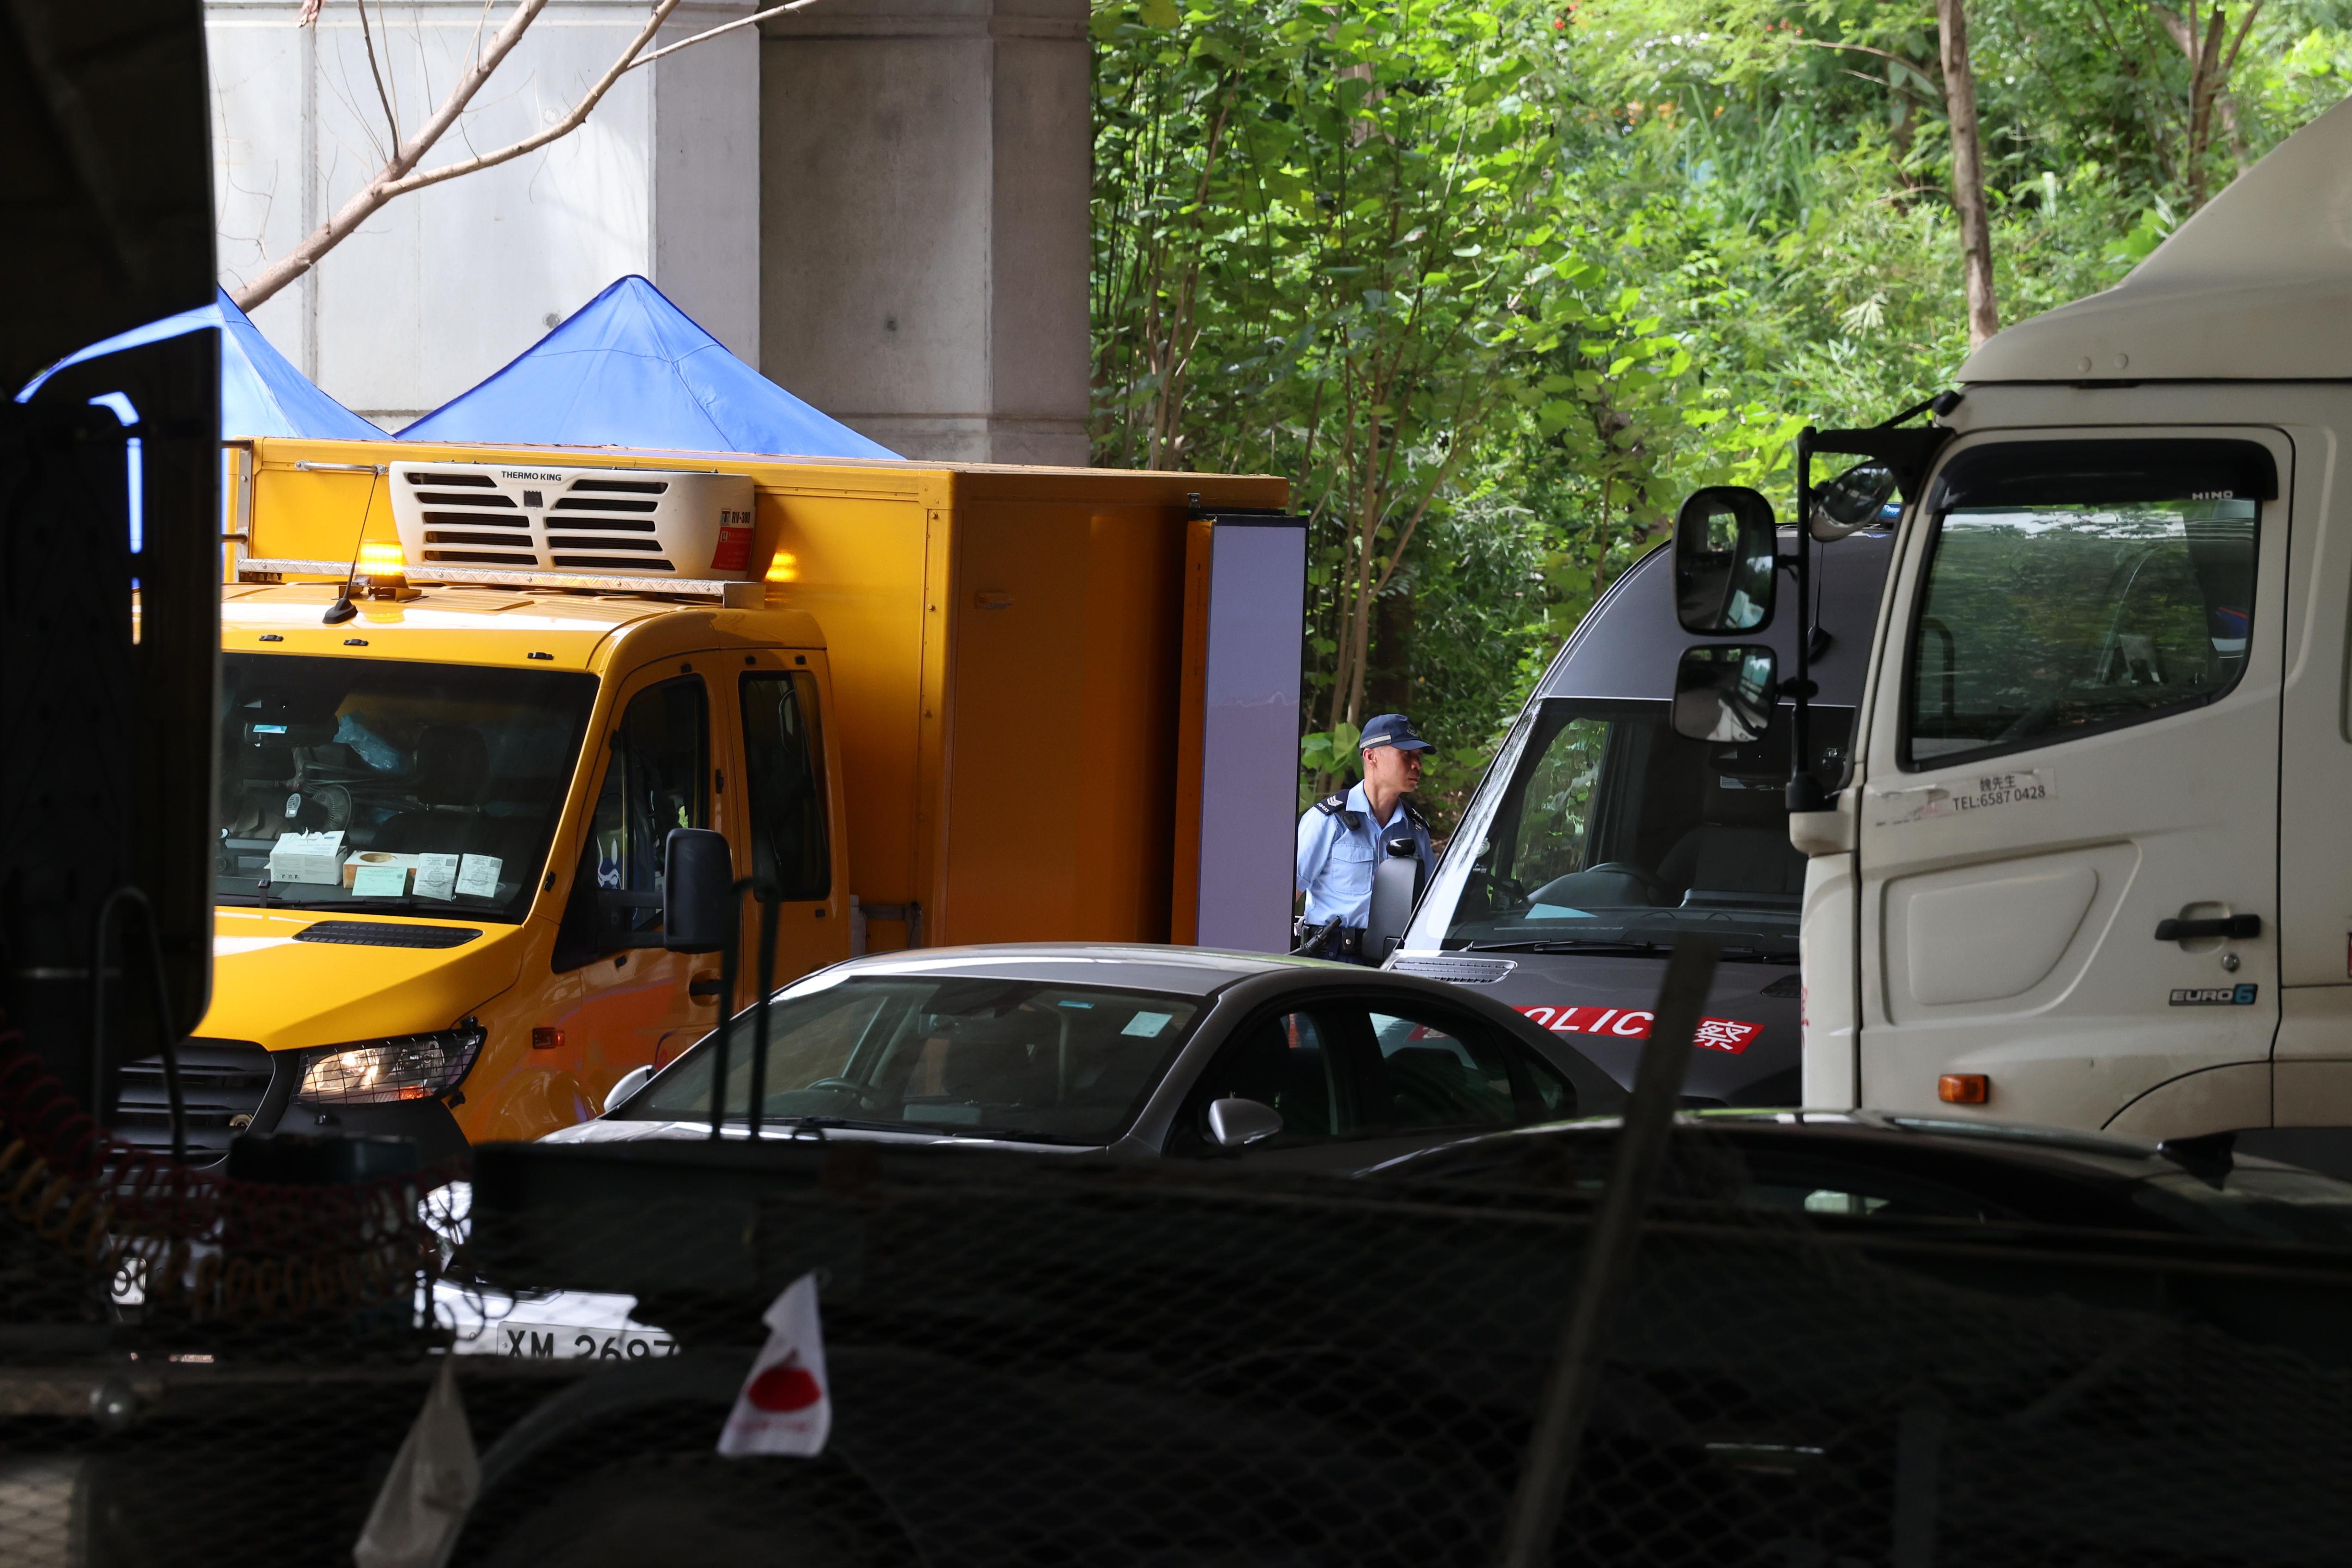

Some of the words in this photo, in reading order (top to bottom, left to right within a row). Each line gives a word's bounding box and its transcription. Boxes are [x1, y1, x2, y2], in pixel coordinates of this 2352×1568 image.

[502, 471, 539, 479] THERMO
[2192, 490, 2233, 500] HINO
[732, 511, 751, 523] RV-380
[1953, 791, 2010, 810] TEL:6587
[2015, 785, 2045, 801] 0428
[1524, 1007, 1655, 1035] OLIC
[1692, 1021, 1753, 1050] 察
[507, 1330, 553, 1358] XM
